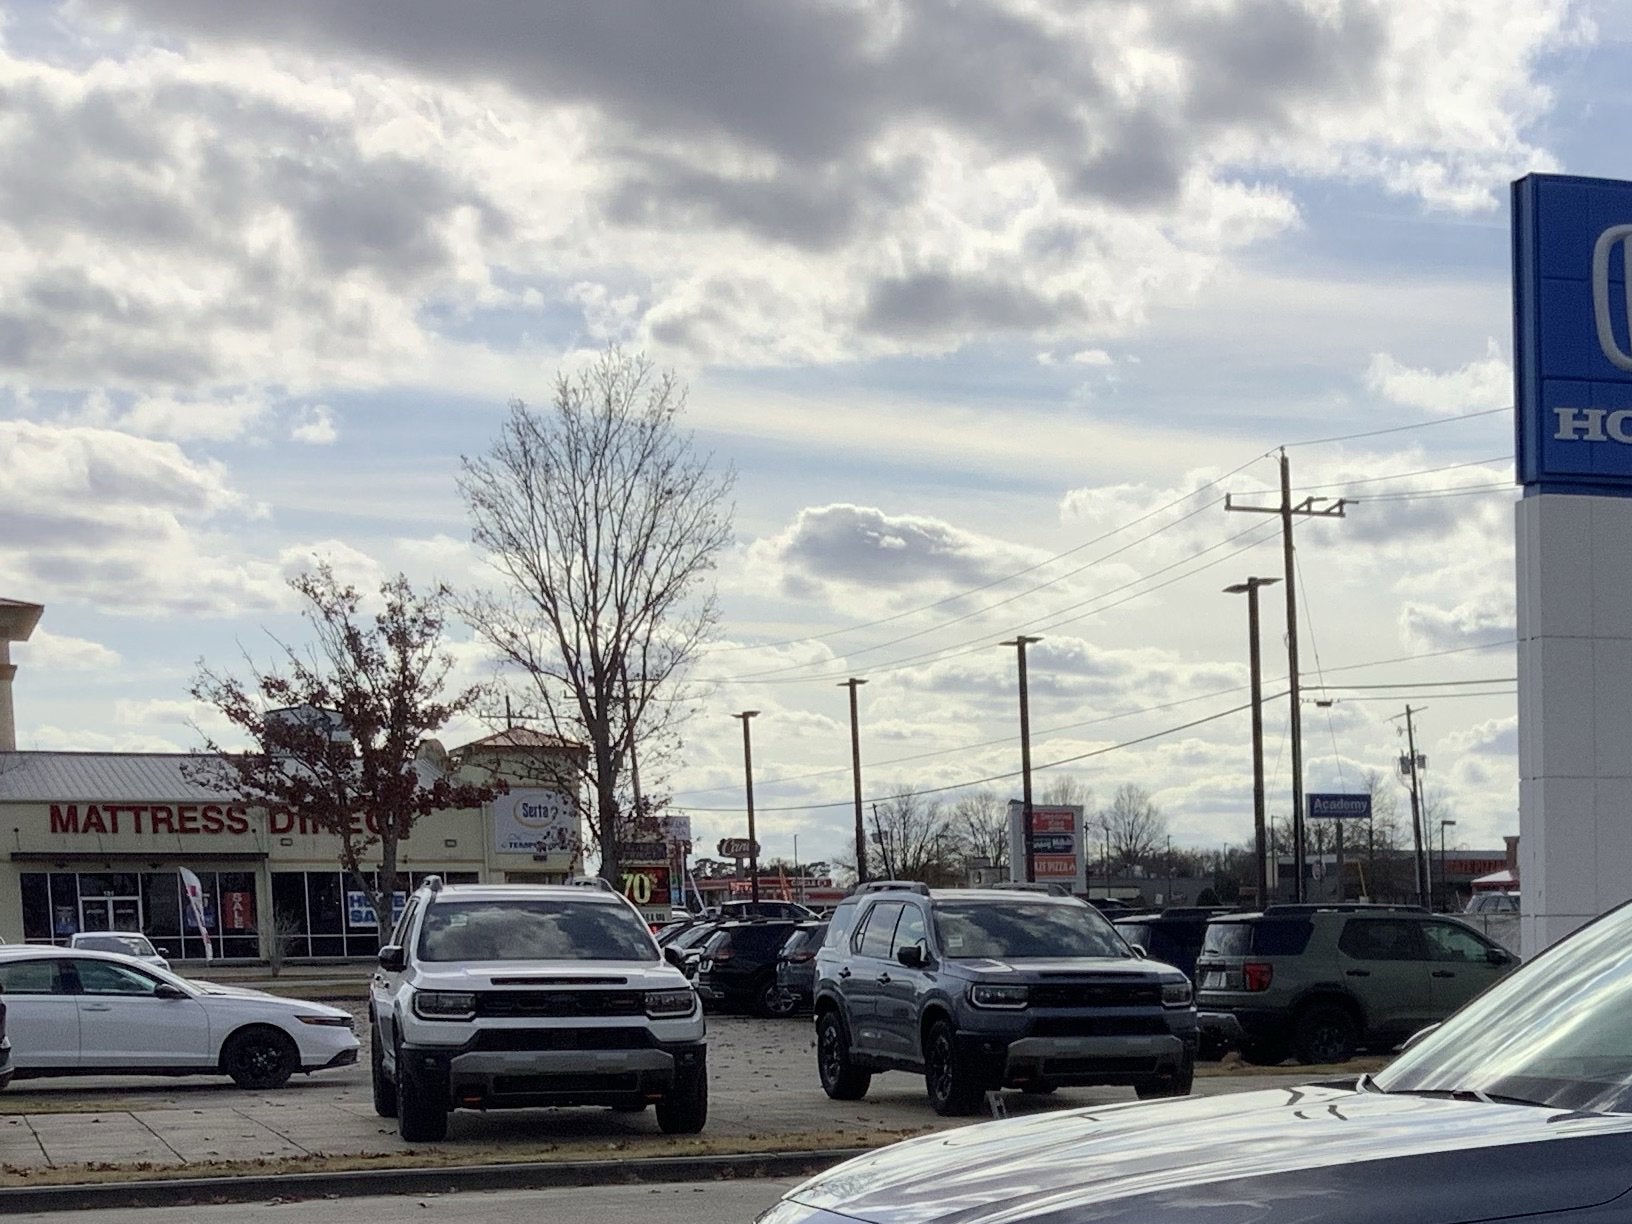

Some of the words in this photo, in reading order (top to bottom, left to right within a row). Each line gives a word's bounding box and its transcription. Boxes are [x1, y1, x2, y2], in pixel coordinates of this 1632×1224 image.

[522, 802, 549, 818] Serta
[1313, 798, 1368, 813] Academy
[50, 804, 249, 834] MATTRESS
[1048, 861, 1068, 872] PIZZA
[232, 892, 244, 929] SALE
